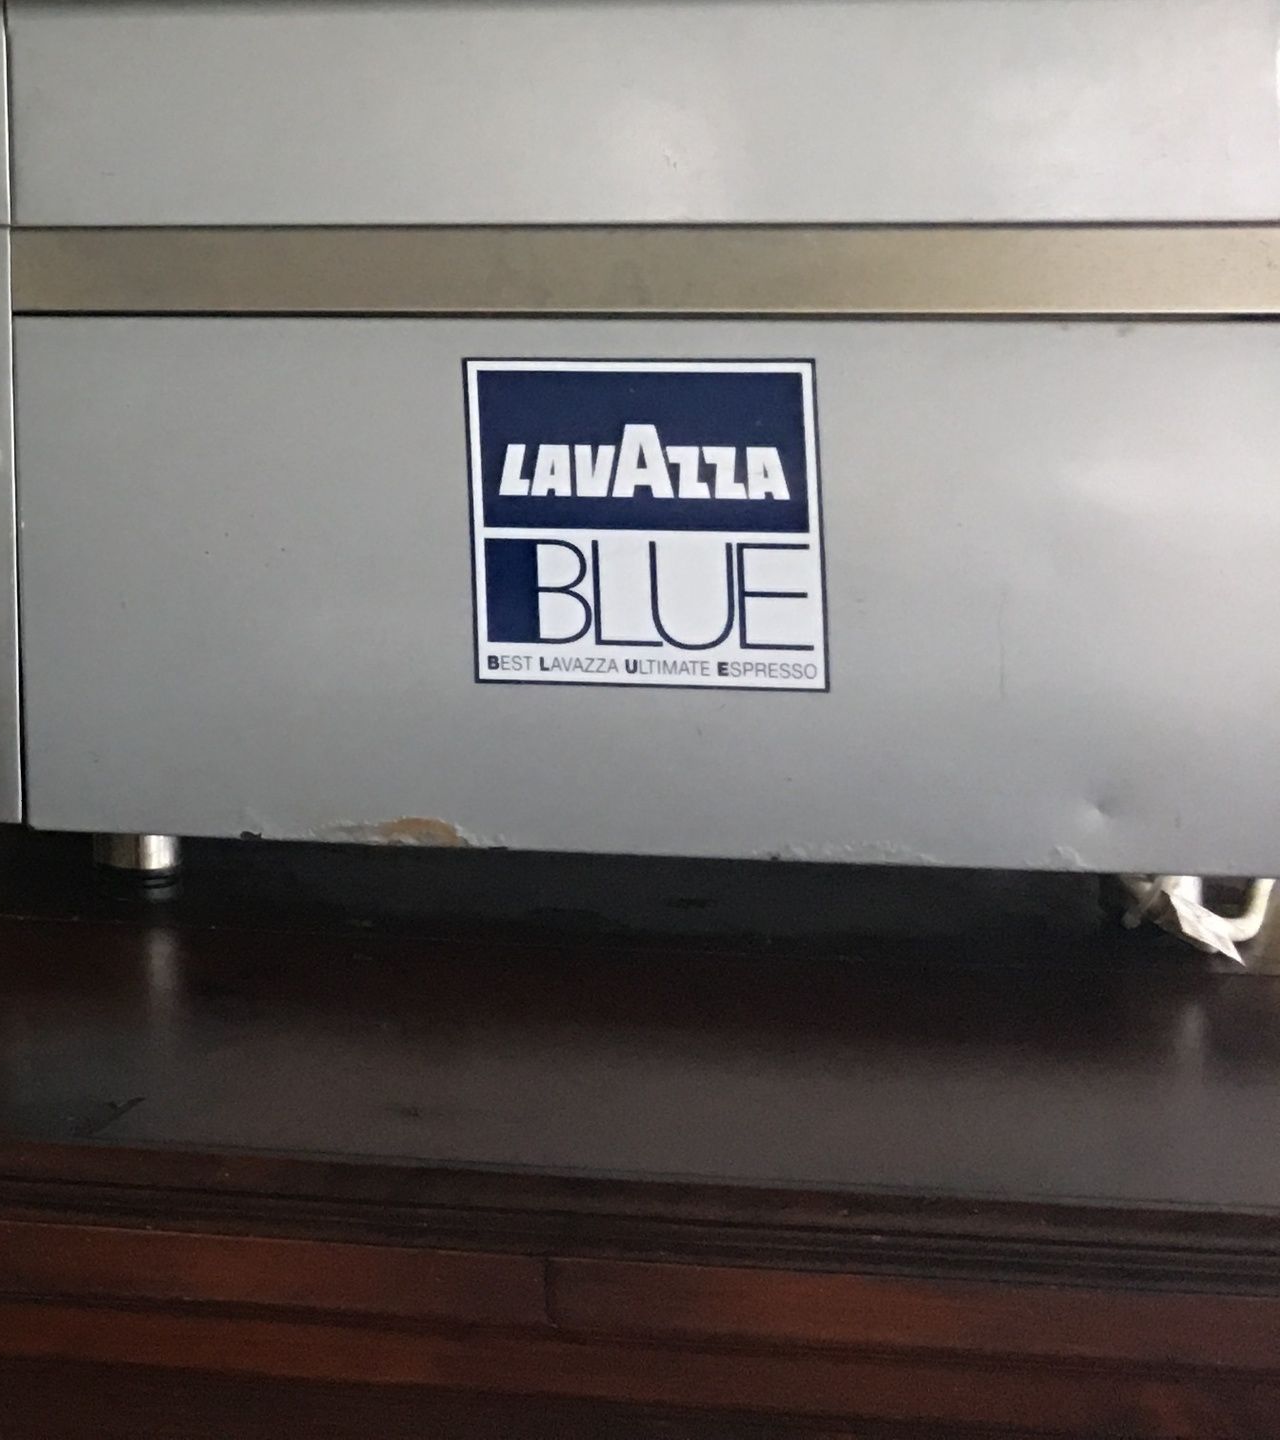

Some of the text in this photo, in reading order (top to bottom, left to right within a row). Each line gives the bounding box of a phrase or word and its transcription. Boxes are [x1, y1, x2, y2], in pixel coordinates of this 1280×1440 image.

[499, 423, 790, 500] LAVAZZA
[485, 537, 815, 651] BLUE
[488, 655, 819, 680] BEST LAVAZZA ULTIMATE ESPRESSO
